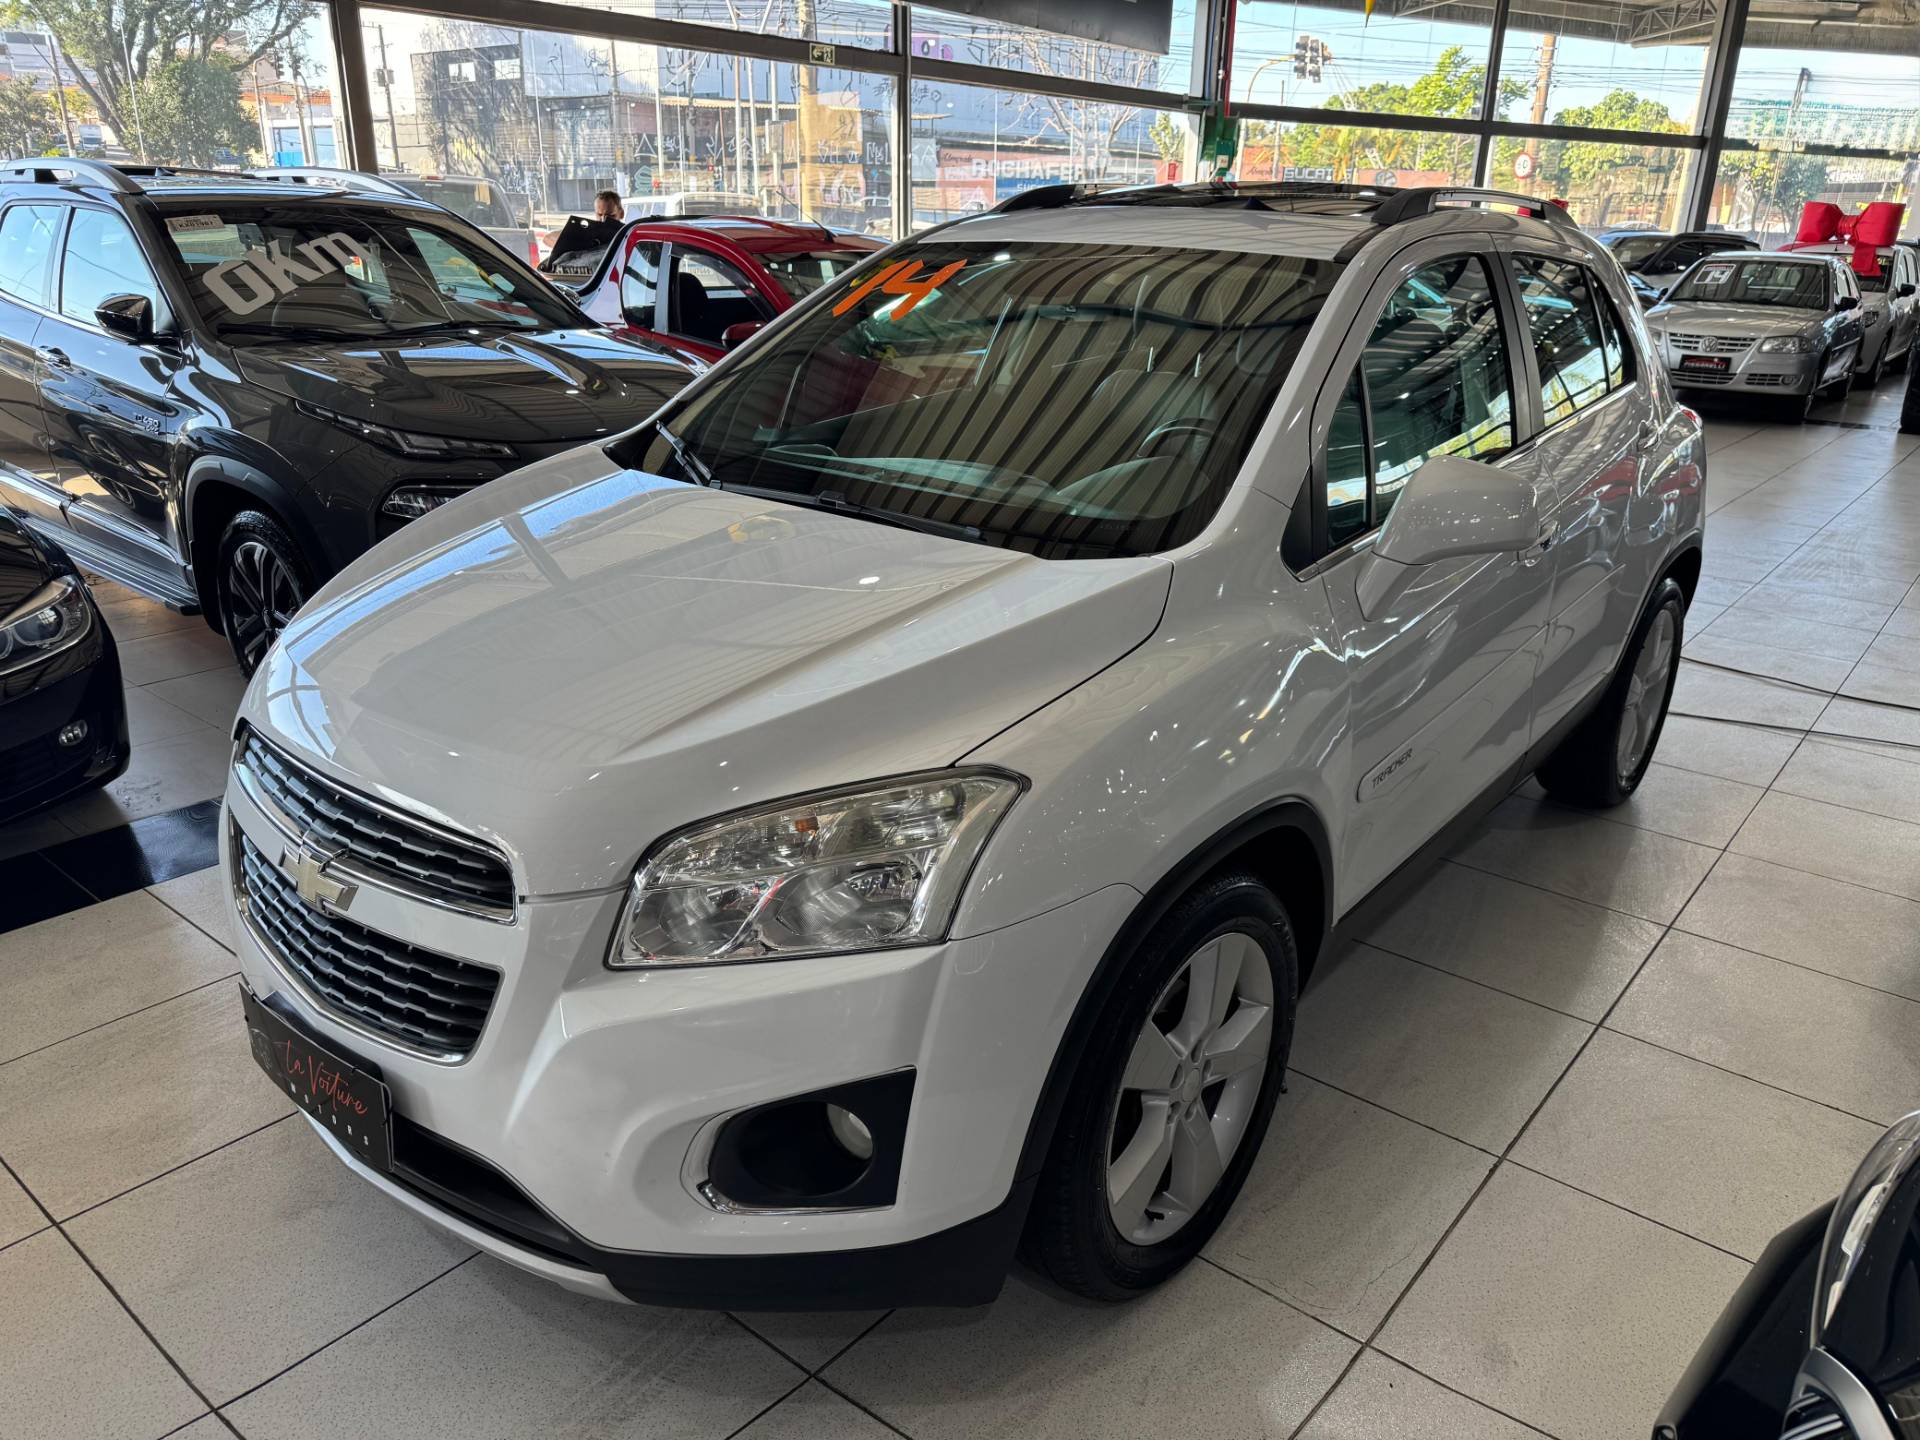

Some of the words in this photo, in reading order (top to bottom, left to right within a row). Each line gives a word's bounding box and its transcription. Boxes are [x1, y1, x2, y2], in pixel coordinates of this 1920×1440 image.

[832, 258, 967, 322] 14
[1372, 747, 1413, 789] TRACKER
[309, 1055, 368, 1115] Voiture
